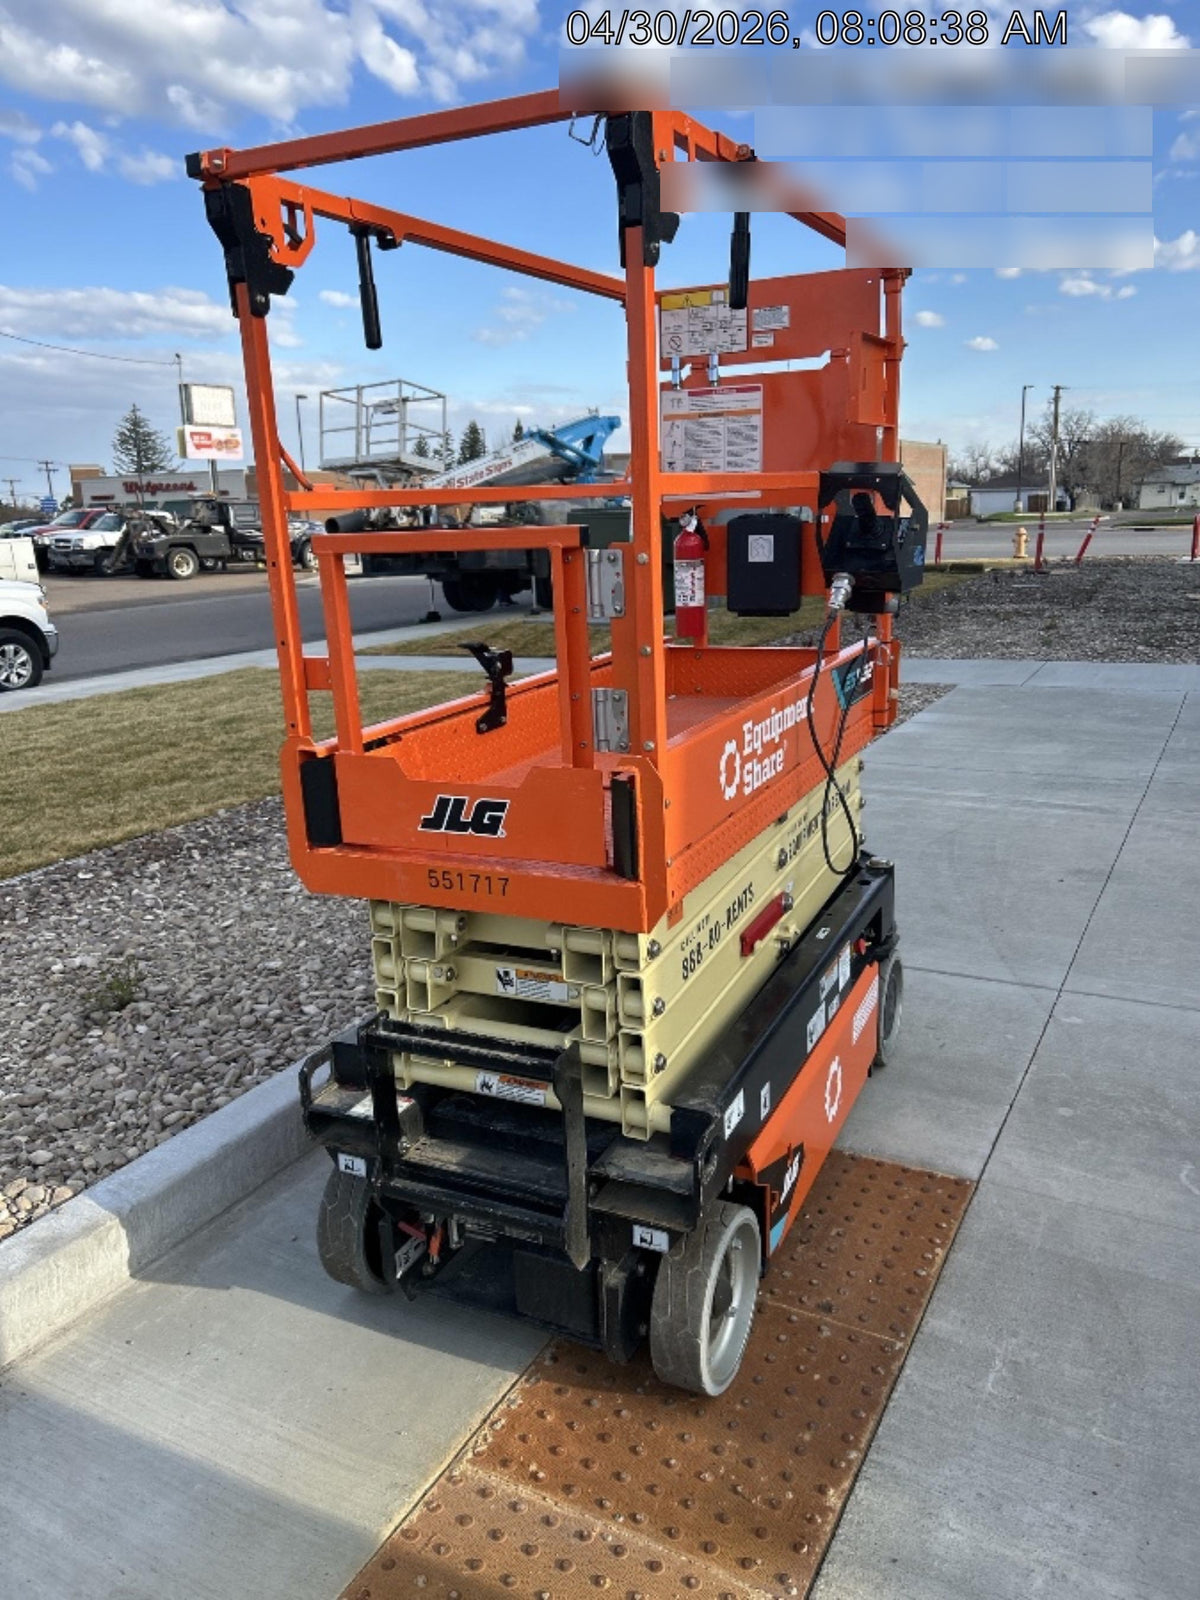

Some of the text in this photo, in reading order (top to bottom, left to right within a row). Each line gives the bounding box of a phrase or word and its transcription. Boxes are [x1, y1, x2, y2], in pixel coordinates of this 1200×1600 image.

[743, 748, 785, 795] Share
[417, 794, 510, 838] JLG
[427, 868, 509, 896] 551717
